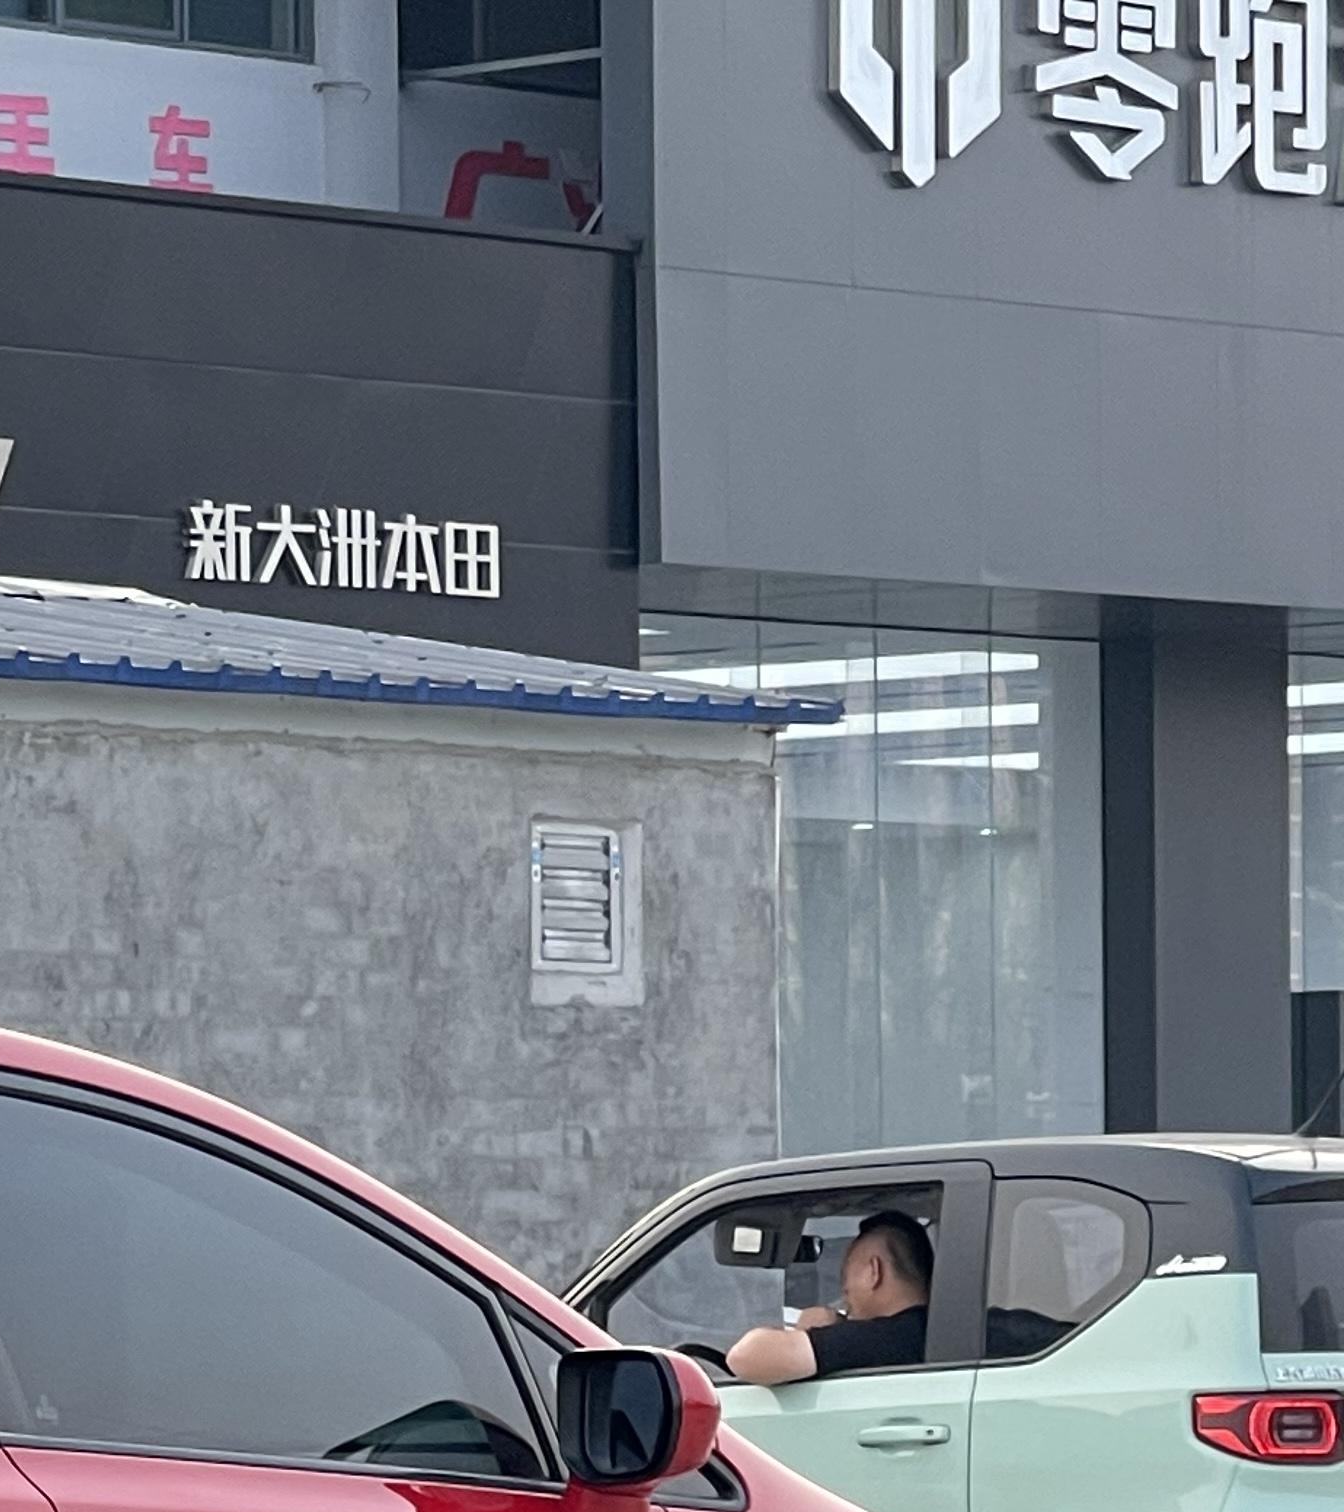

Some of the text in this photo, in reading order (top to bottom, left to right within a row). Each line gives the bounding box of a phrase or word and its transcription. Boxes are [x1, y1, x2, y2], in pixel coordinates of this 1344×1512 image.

[1036, 0, 1327, 195] 零跑
[186, 499, 500, 598] 新大洲本田
